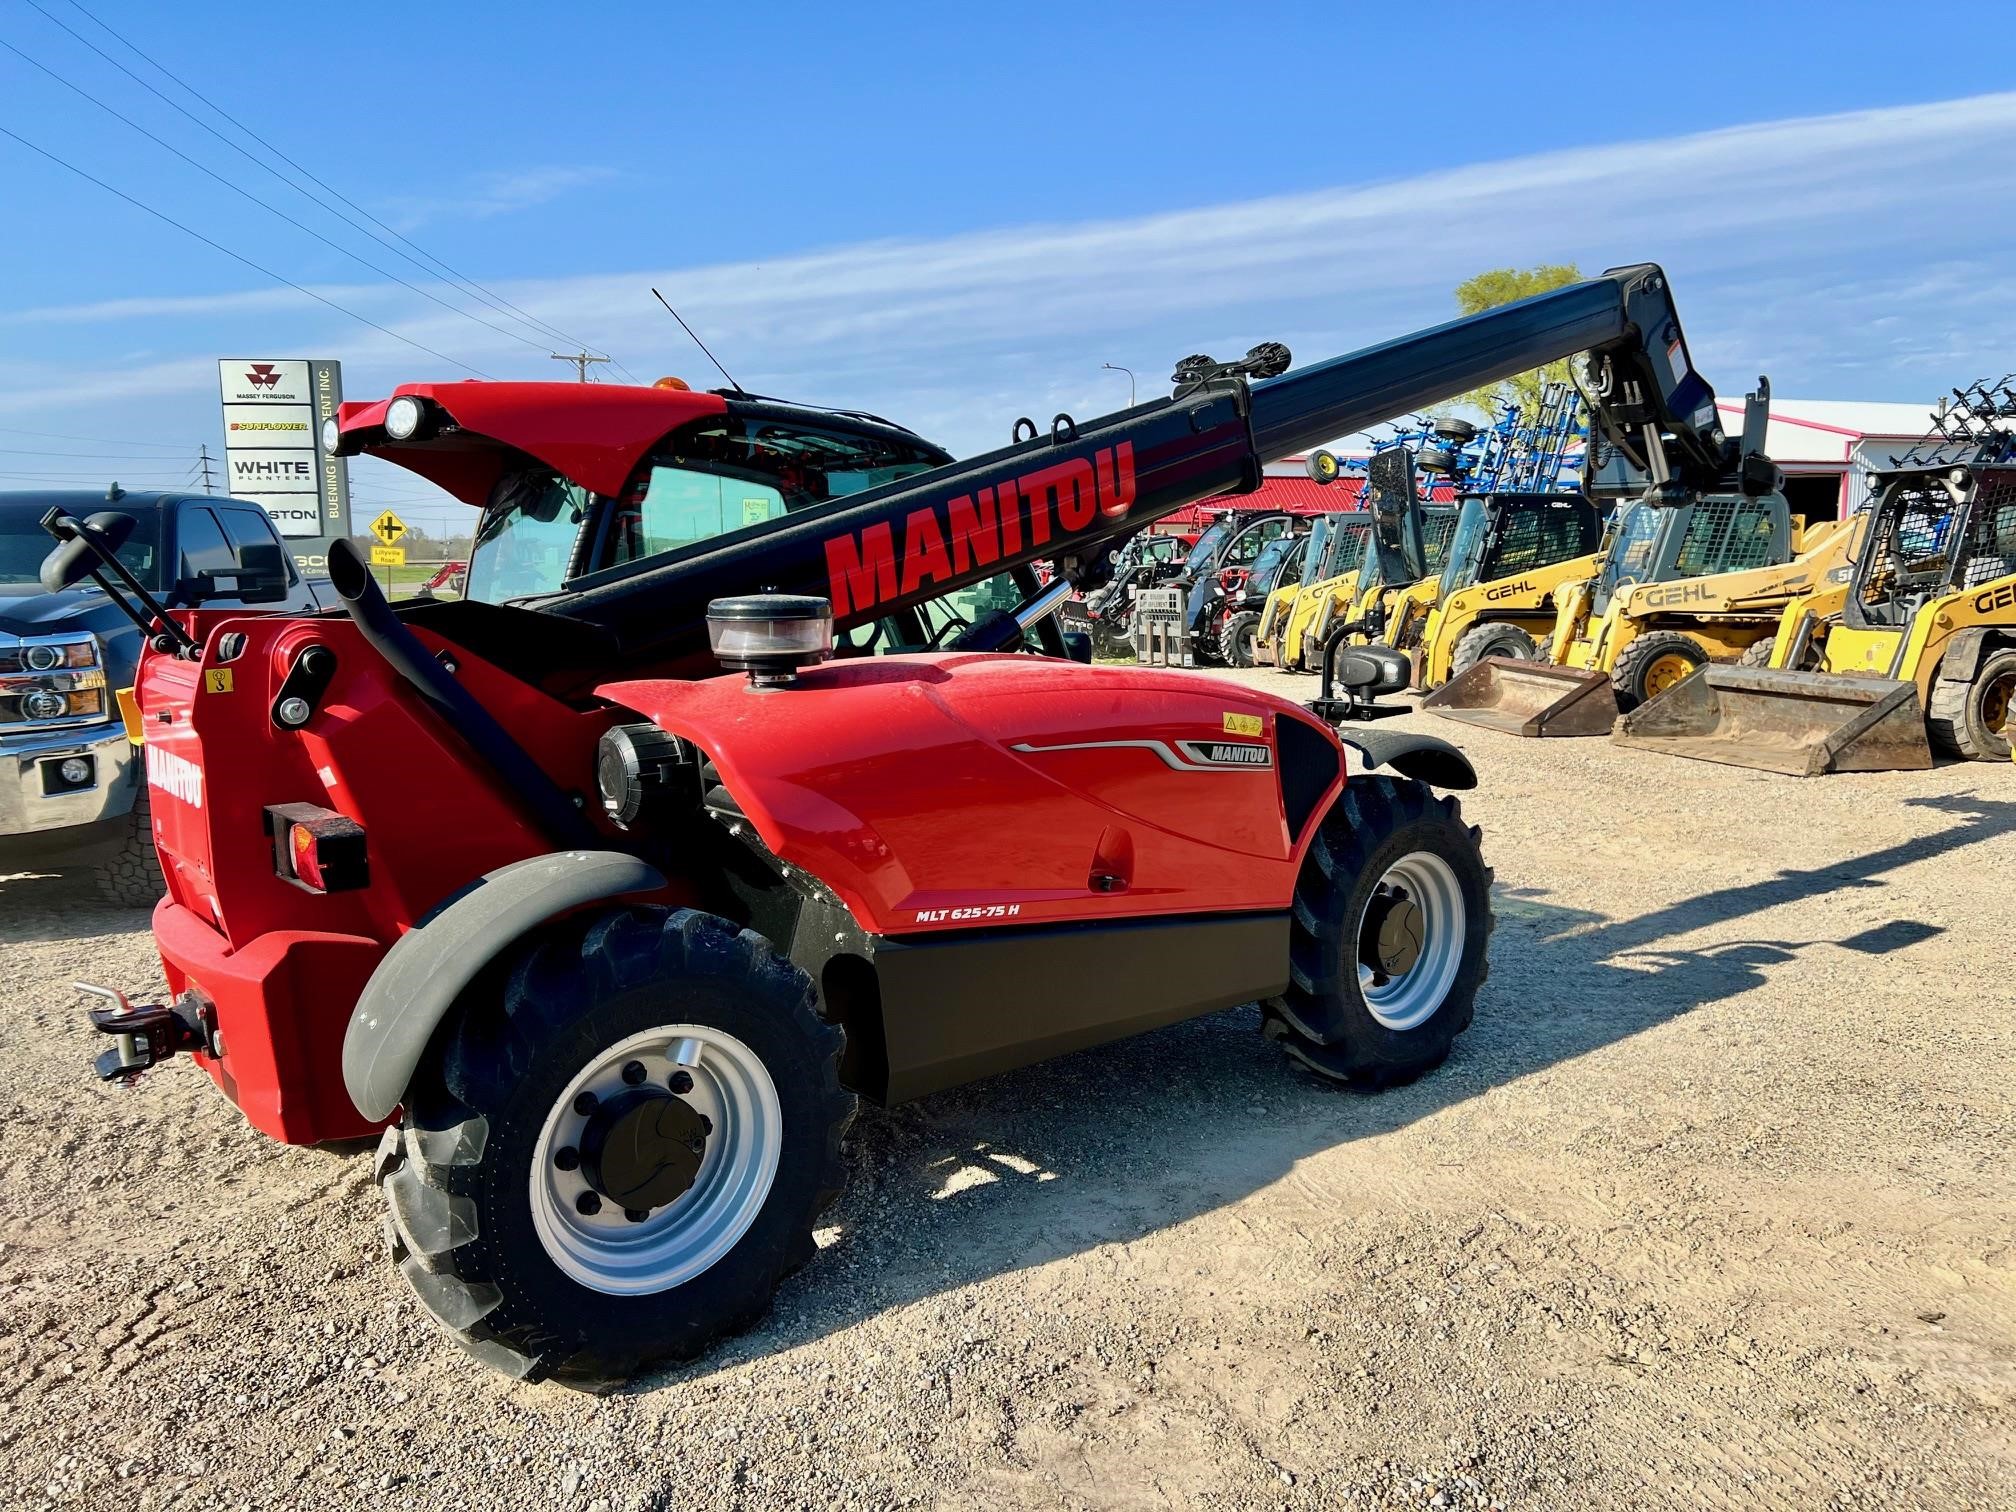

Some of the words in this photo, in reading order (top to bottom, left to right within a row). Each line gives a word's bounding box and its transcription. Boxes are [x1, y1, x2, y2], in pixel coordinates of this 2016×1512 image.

[318, 368, 331, 391] INC.
[239, 422, 306, 431] SUNFLOWER
[234, 461, 310, 474] WHITE
[325, 466, 339, 519] BUENING
[268, 510, 317, 520] STON
[824, 440, 1136, 620] MANITOU
[1486, 580, 1537, 601] GEHL
[1645, 582, 1718, 607] GEHL
[1974, 583, 2016, 615] GE
[1211, 745, 1267, 762] MANITOU
[147, 743, 203, 809] MANITOU
[916, 909, 950, 923] MLT
[951, 905, 1006, 920] 625-75
[1007, 904, 1020, 916] H
